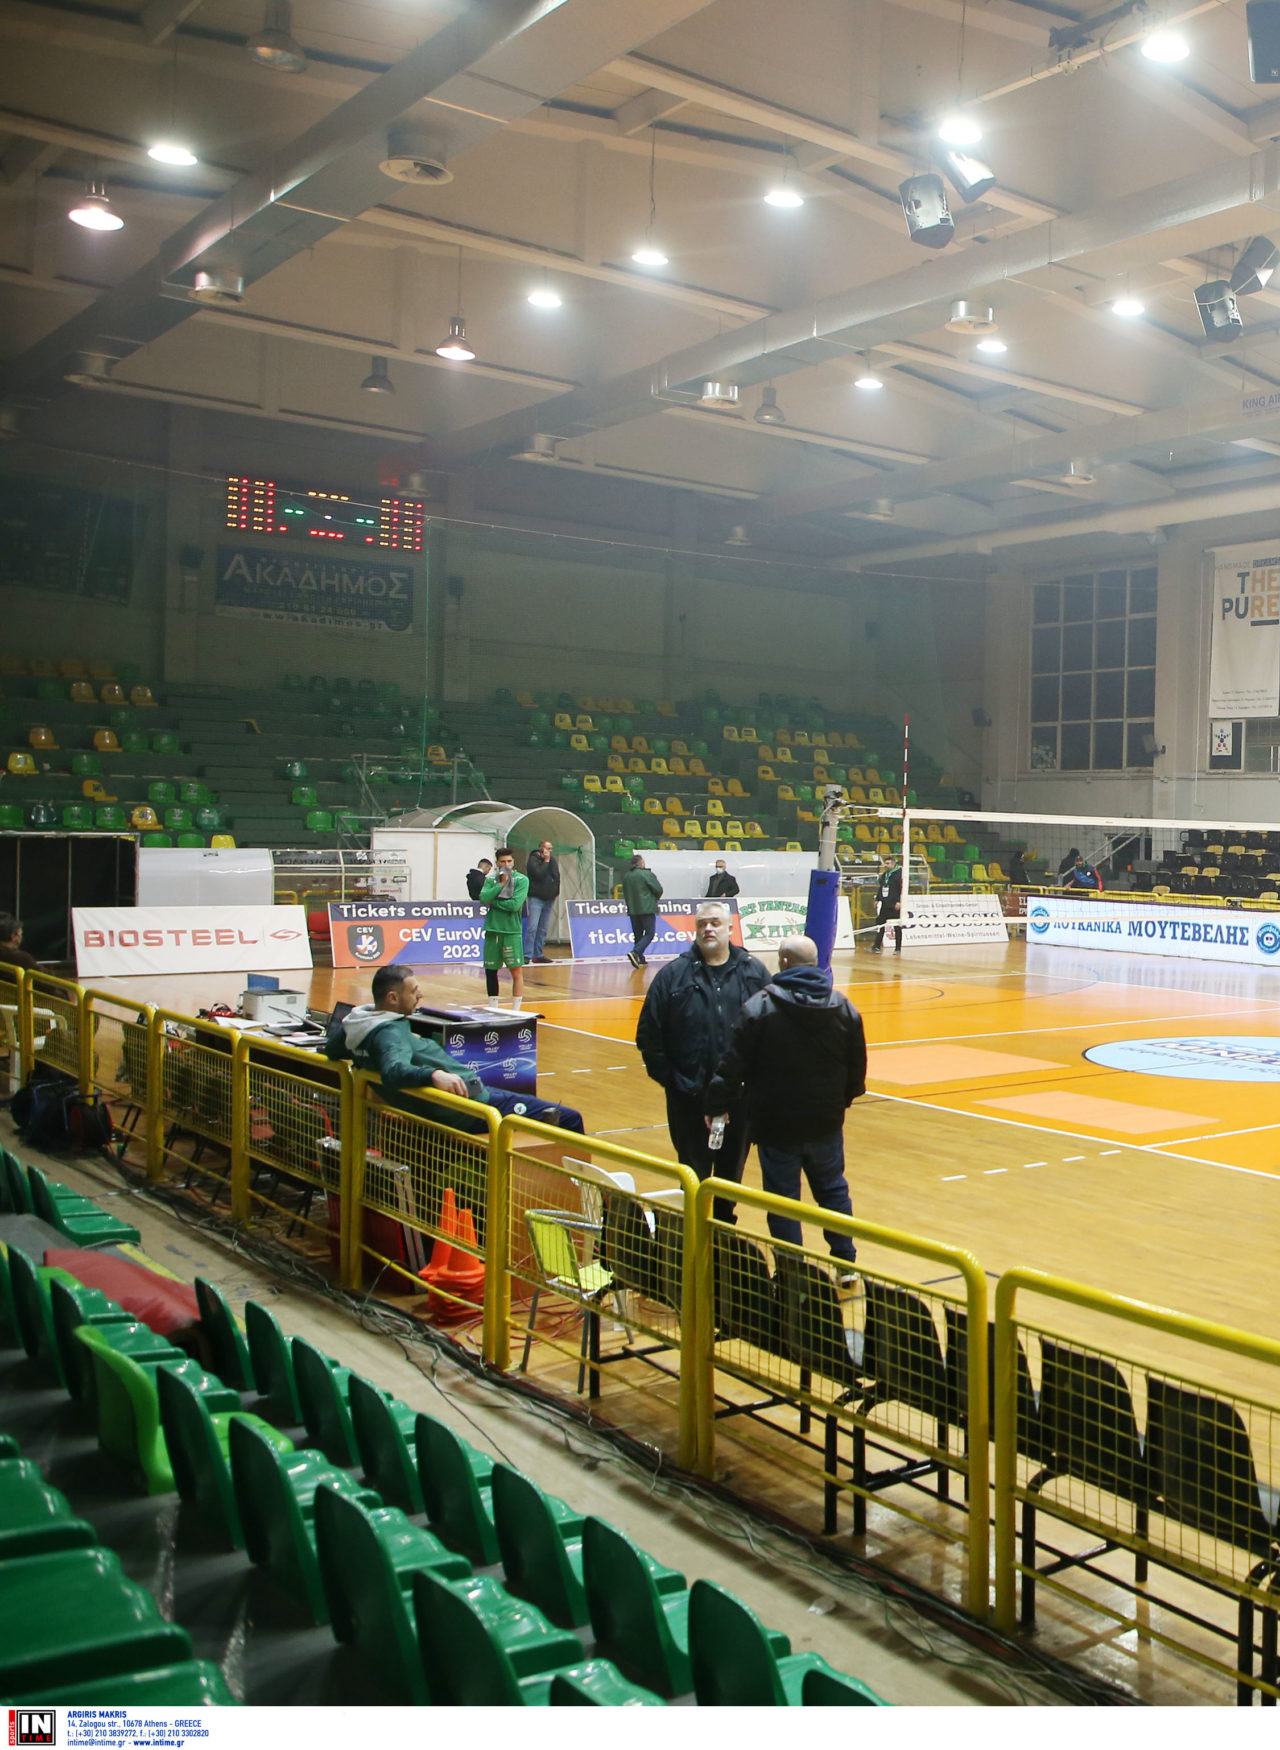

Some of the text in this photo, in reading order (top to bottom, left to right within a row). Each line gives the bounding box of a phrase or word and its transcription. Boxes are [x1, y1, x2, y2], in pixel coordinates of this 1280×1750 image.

[1242, 397, 1266, 409] KING
[223, 553, 409, 599] ΑΚΑΔΗΜΟΣ
[1237, 568, 1280, 594] THE
[1222, 594, 1280, 621] PURE
[339, 904, 405, 918] Tickets
[411, 903, 474, 919] coming
[657, 901, 692, 915] ming
[758, 901, 807, 916] FANTAS
[356, 926, 374, 934] CEV
[399, 928, 433, 942] CEV
[1128, 920, 1250, 946] ΜΟΥΤΕΒΕΛΗΣ
[84, 929, 259, 947] BIOSTEEL
[442, 944, 481, 958] 2023
